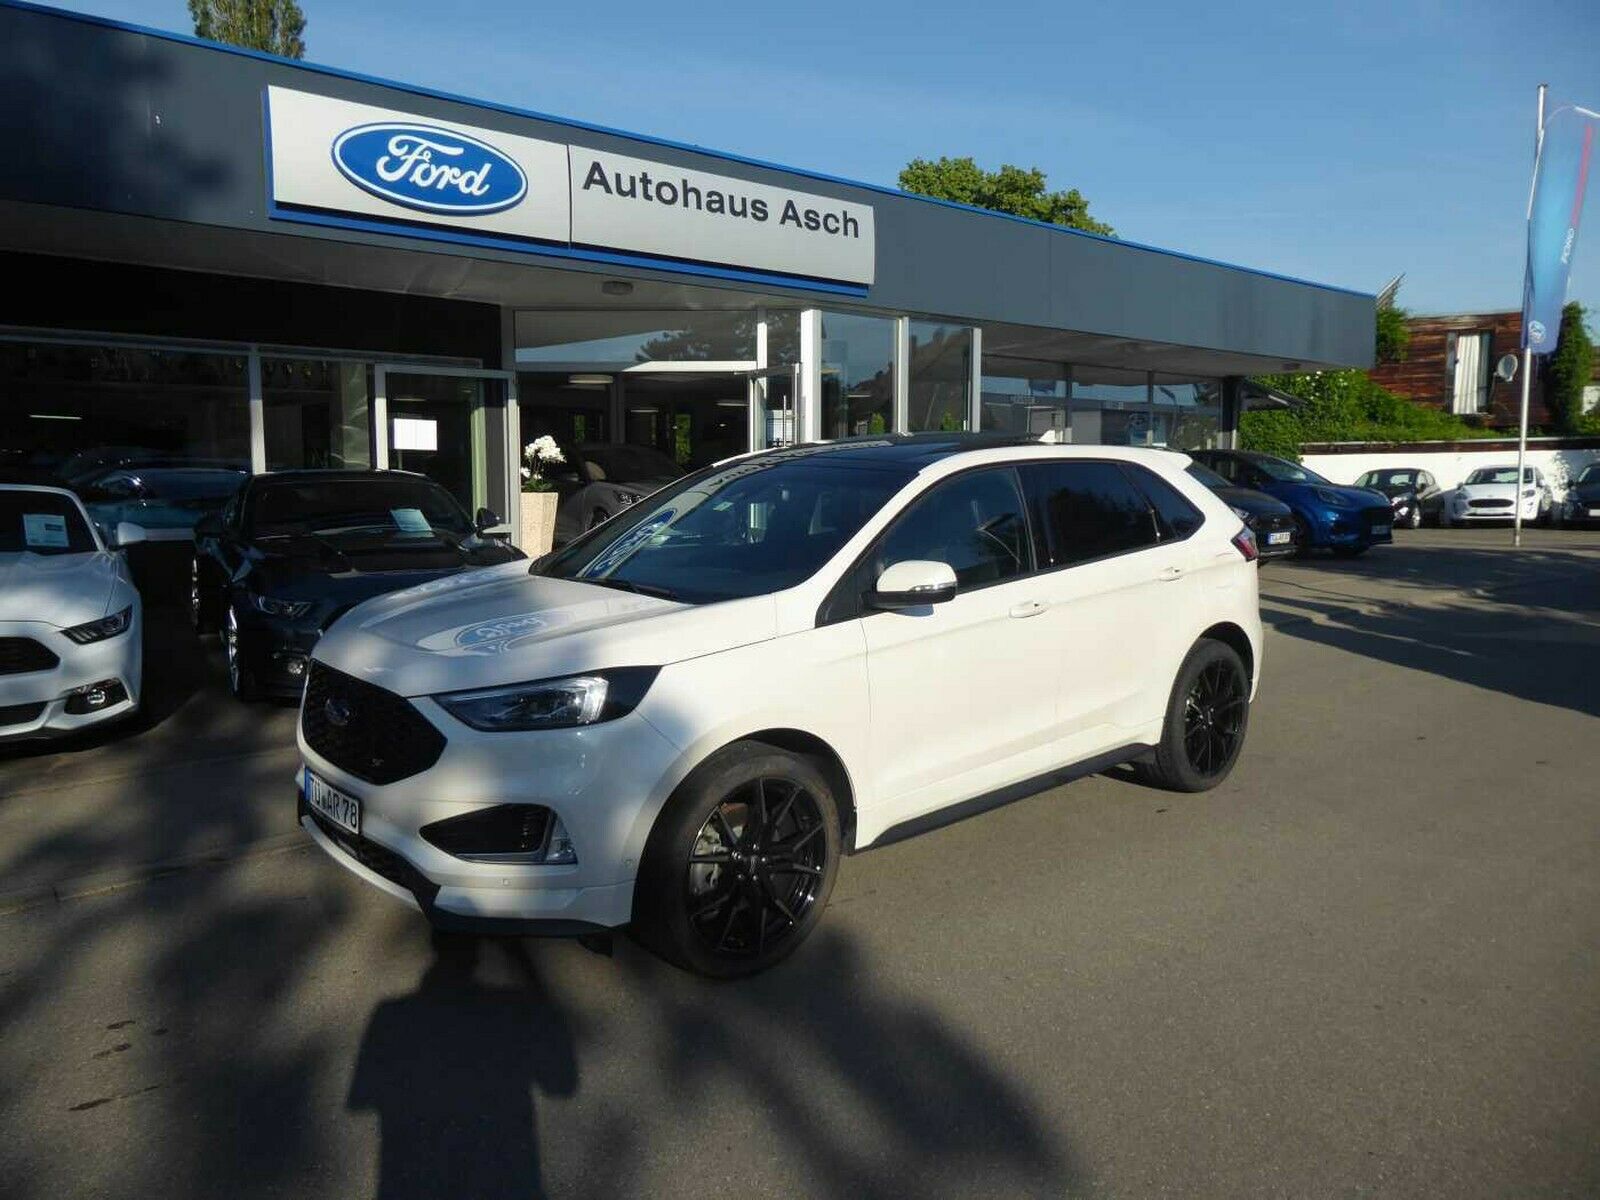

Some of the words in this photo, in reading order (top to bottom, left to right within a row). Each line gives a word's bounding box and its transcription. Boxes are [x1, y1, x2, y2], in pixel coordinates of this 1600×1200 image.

[376, 134, 493, 196] Ford
[582, 160, 769, 222] Autohaus
[779, 199, 860, 239] Asch
[343, 799, 358, 829] 78
